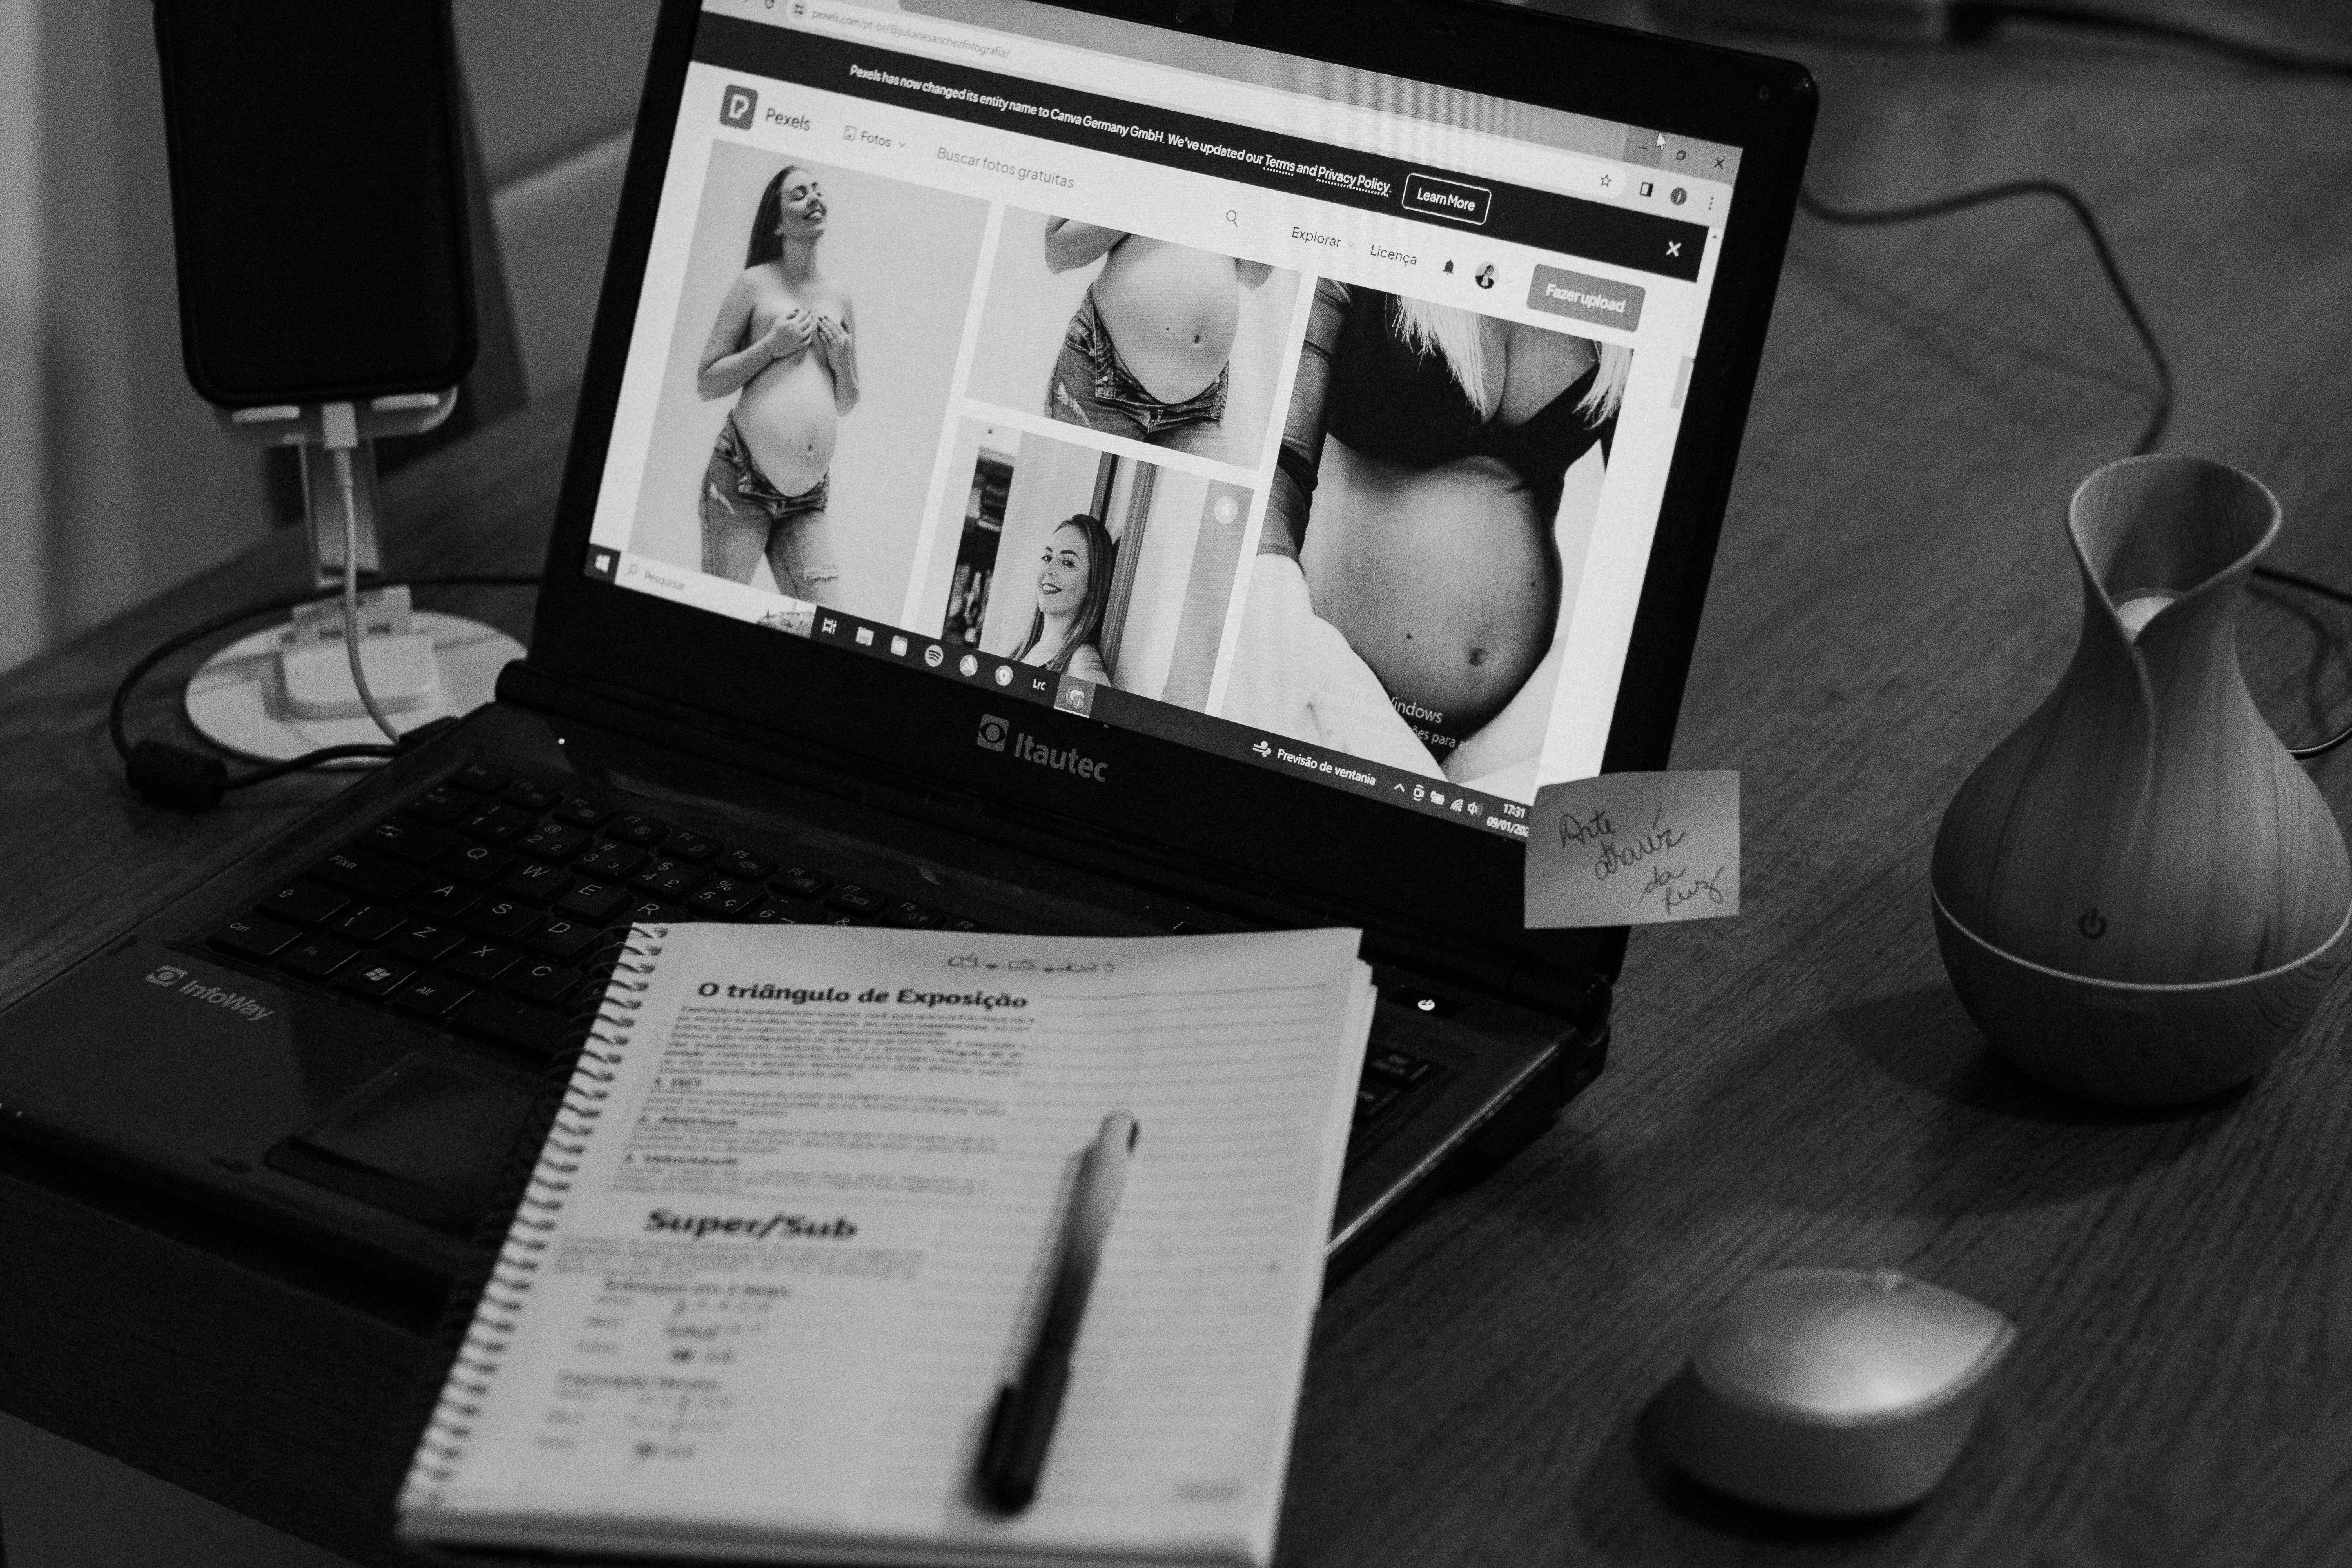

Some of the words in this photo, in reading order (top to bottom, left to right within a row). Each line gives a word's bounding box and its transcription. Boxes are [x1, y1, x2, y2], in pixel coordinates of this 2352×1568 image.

[766, 108, 811, 131] Pexels
[849, 64, 880, 82] Pexels
[882, 72, 899, 86] has
[900, 76, 922, 90] now
[922, 81, 965, 100] changed
[967, 89, 979, 103] its
[980, 94, 1010, 111] entity
[1009, 100, 1037, 116] name
[1038, 106, 1049, 118] to
[1050, 108, 1082, 126] Canva
[1083, 115, 1129, 137] Germany
[1130, 125, 1165, 143] GmbH.
[1168, 133, 1200, 151] We've
[1200, 143, 1245, 161] updated
[1246, 153, 1265, 165] our
[1265, 154, 1295, 172] Terms
[1296, 164, 1318, 177] and
[1318, 166, 1357, 188] Privacy
[1357, 174, 1392, 194] Policy.
[861, 130, 891, 147] Fotos
[937, 147, 981, 168] Buscar
[982, 157, 1016, 175] fotos
[1018, 167, 1075, 189] gratuitas
[1417, 187, 1448, 206] Learn
[1447, 194, 1476, 212] More
[1292, 226, 1342, 248] Explorar
[1370, 244, 1418, 267] Licença
[1546, 283, 1580, 303] Fazer
[1580, 294, 1626, 313] upload
[1432, 733, 1456, 748] para
[1014, 732, 1109, 782] Itautec
[1277, 748, 1318, 769] Previsão
[1319, 761, 1333, 773] de
[1335, 766, 1376, 786] ventania
[1559, 810, 1616, 849] Arte
[526, 835, 543, 843] 2
[467, 848, 488, 860] Q
[584, 853, 599, 862] 3
[733, 850, 750, 859] F5
[523, 865, 550, 878] W
[642, 873, 658, 881] 4
[788, 867, 804, 876] F6
[433, 885, 454, 897] A
[579, 884, 602, 896] E
[717, 880, 734, 891] %
[699, 891, 716, 900] 5
[492, 903, 512, 914] S
[637, 902, 661, 915] R
[760, 909, 775, 918] 6
[230, 922, 251, 933] Ctrl
[413, 926, 437, 938] Z
[548, 922, 571, 933] D
[469, 945, 495, 957] X
[532, 965, 552, 976] C
[178, 979, 276, 1021] InfoWay
[698, 982, 720, 998] O
[727, 983, 850, 1005] triângulo
[857, 988, 889, 1004] de
[896, 988, 1028, 1011] Exposição
[646, 1208, 858, 1239] Super/Sub
